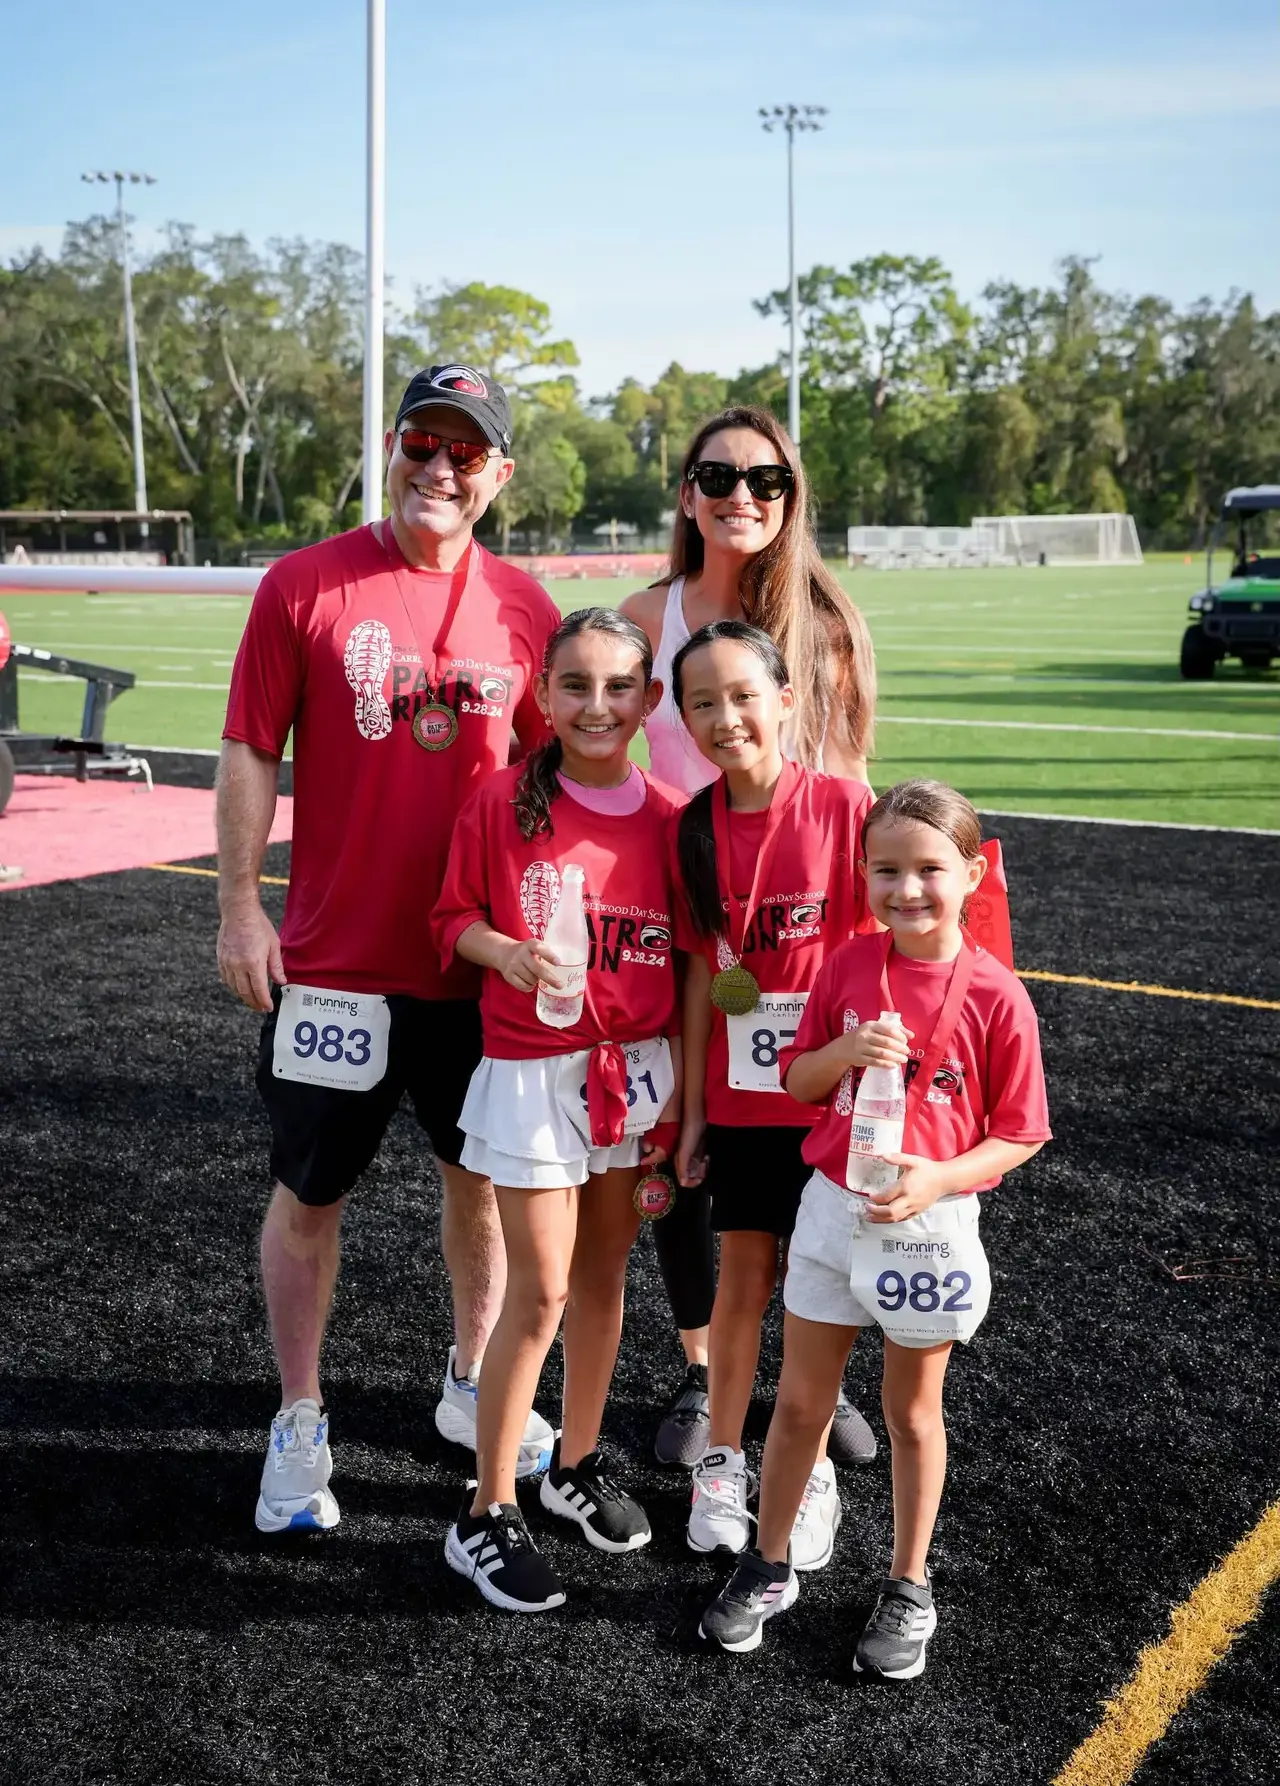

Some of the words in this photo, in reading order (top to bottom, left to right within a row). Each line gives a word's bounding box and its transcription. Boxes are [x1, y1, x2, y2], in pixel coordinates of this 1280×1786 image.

[466, 658, 485, 670] DAY
[485, 662, 513, 677] SCHOOL
[461, 701, 503, 718] 9.28.24
[777, 893, 794, 903] DAY
[794, 890, 826, 901] SCHOOL
[582, 901, 629, 915] OLLWOOD
[630, 905, 647, 918] DAY
[647, 909, 671, 923] SCHO
[743, 930, 778, 953] UN
[778, 926, 821, 940] 9.28.24
[587, 943, 622, 974] UN
[621, 949, 666, 967] 9.28.24
[314, 996, 358, 1017] running
[766, 1000, 805, 1012] runnin
[293, 1020, 372, 1066] 983
[941, 1056, 966, 1069] CHOOL
[895, 1240, 950, 1259] running
[876, 1270, 973, 1313] 982
